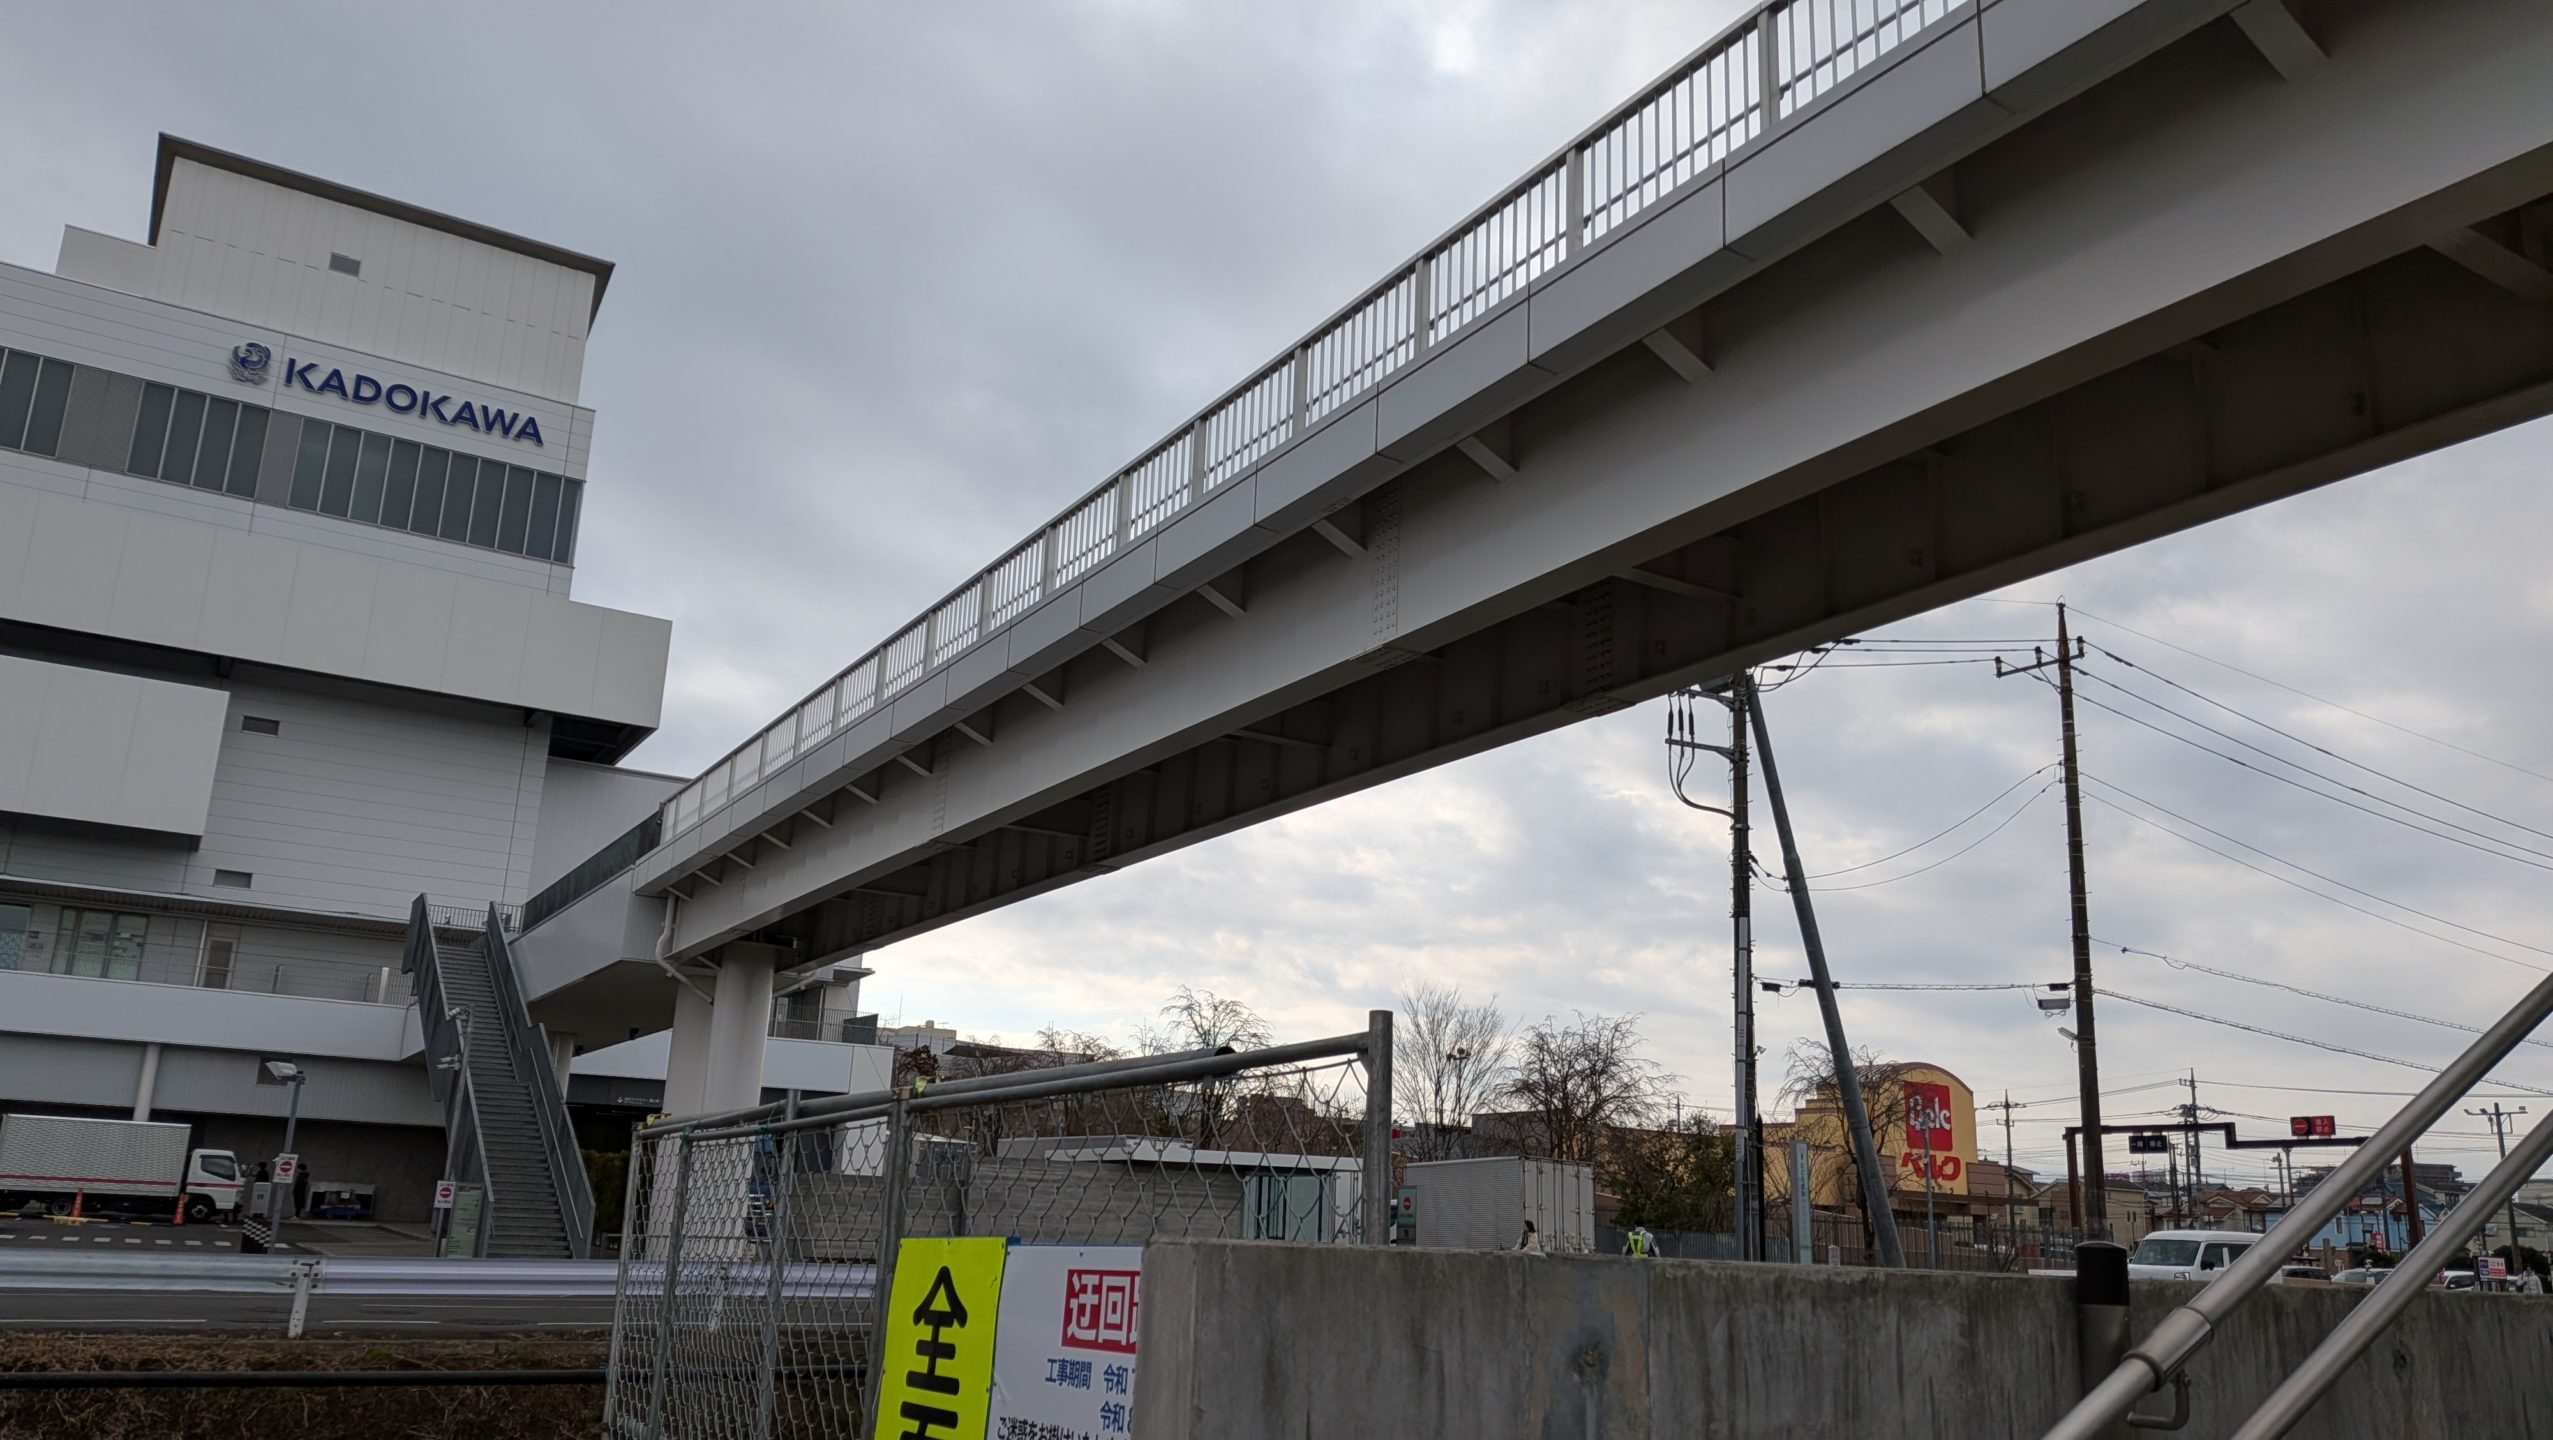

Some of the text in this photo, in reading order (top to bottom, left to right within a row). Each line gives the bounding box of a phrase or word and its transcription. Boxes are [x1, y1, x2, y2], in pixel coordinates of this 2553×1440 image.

[284, 357, 545, 448] KADOKAWA
[1901, 1151, 1962, 1182] ベルク
[1045, 1358, 1093, 1390] 工事期間
